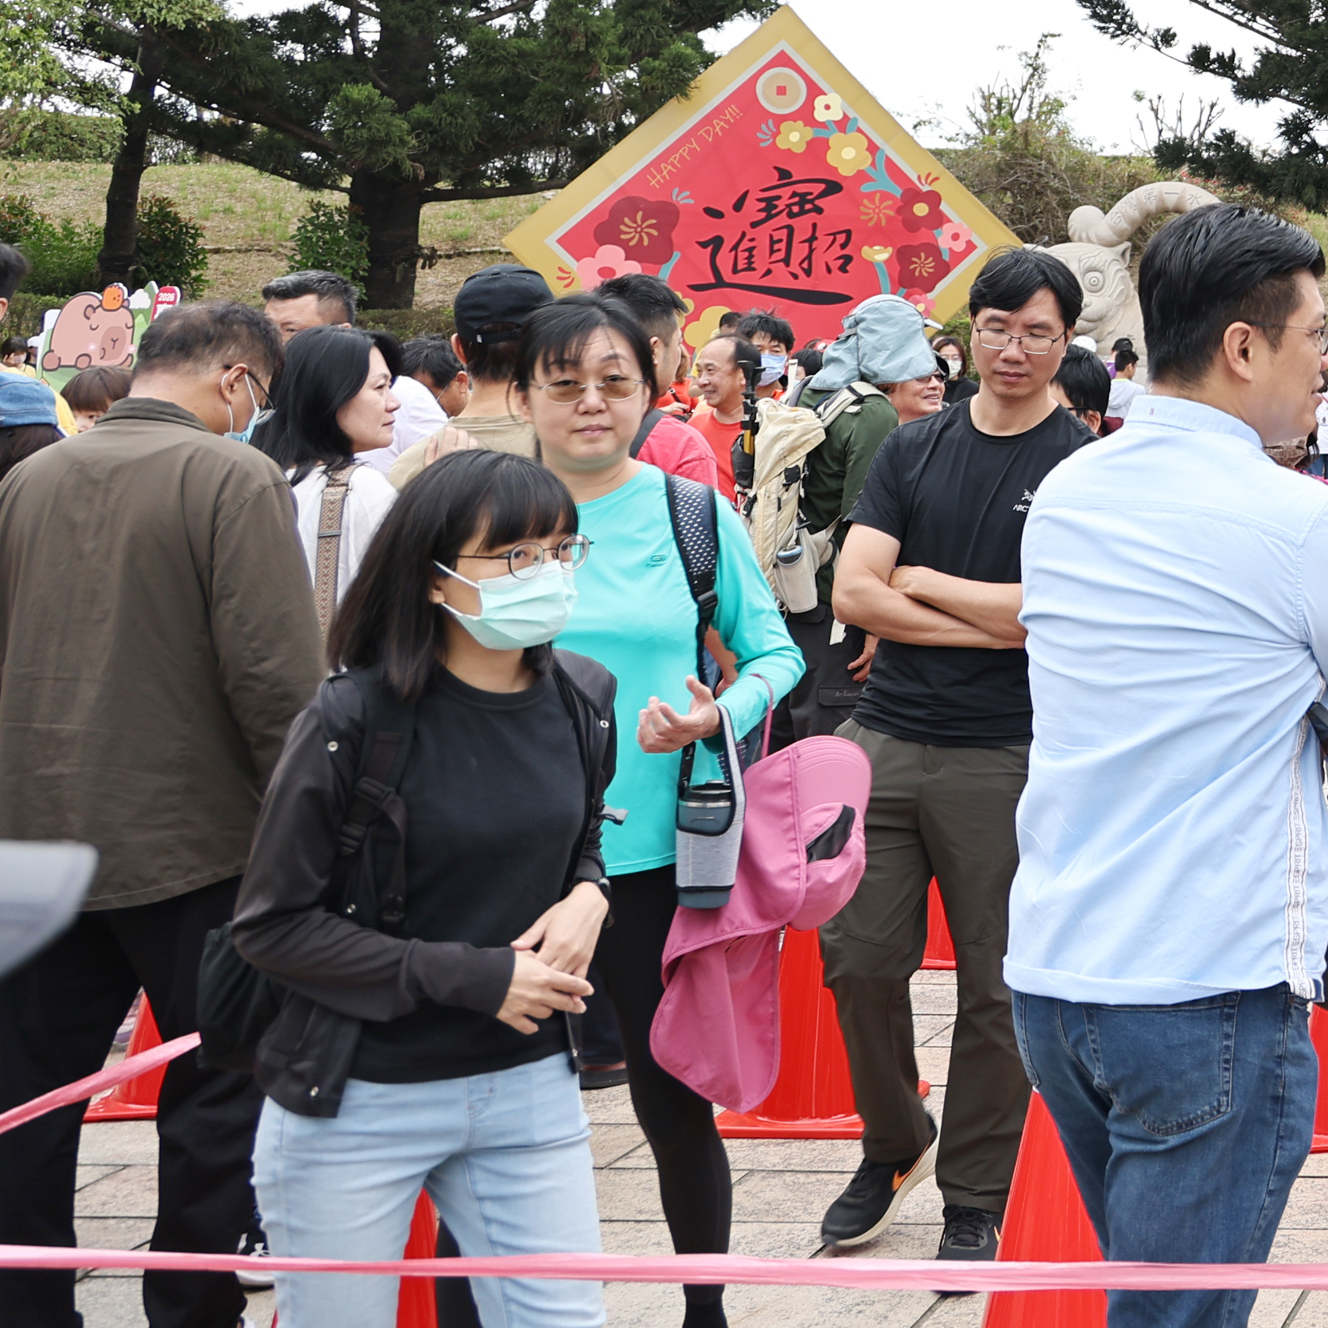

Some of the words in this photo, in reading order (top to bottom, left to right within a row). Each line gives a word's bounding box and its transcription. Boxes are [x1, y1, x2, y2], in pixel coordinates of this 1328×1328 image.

[646, 138, 701, 189] HAPPY
[697, 104, 743, 142] DAY!!
[158, 293, 175, 302] 2026
